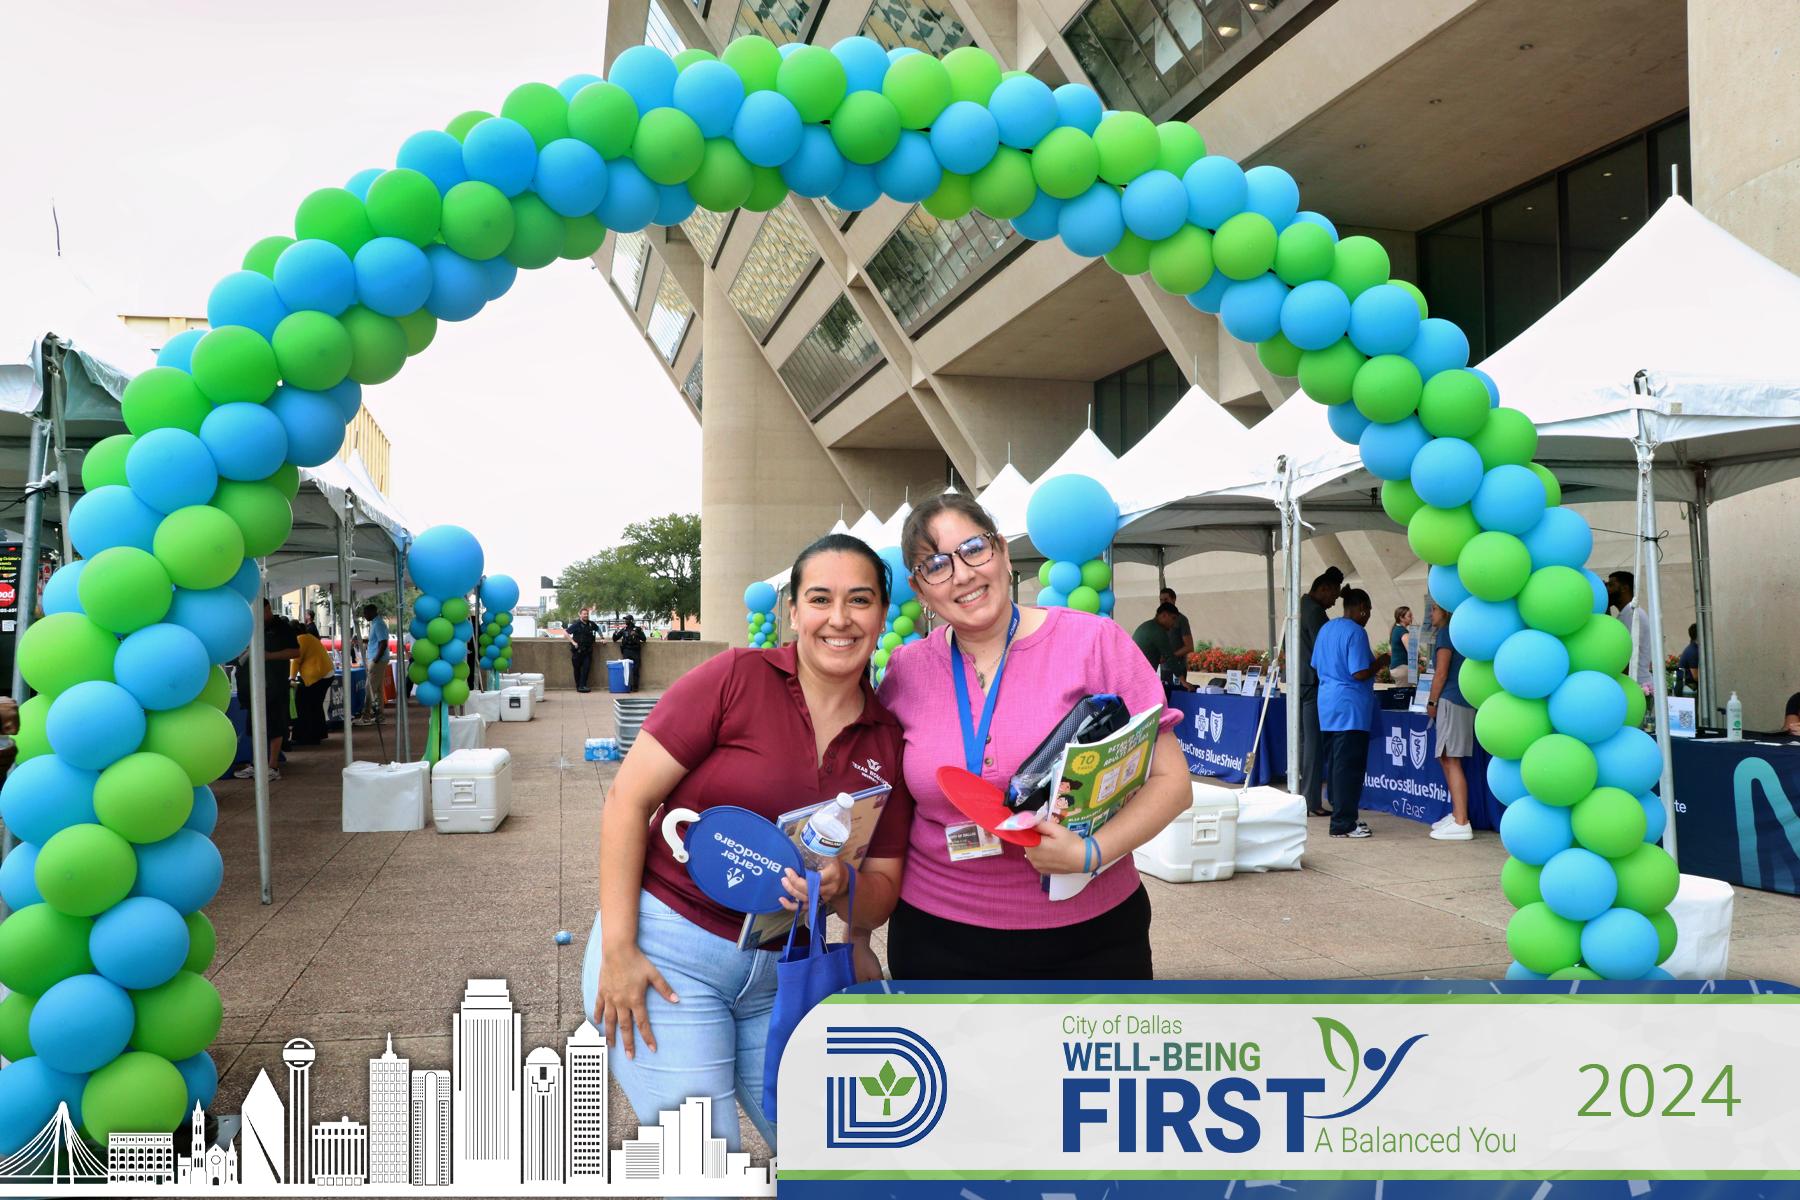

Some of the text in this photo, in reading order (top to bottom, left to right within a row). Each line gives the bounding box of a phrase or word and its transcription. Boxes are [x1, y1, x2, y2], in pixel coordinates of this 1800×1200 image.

[1205, 749, 1242, 771] BlueShield
[1363, 772, 1407, 793] lueCross
[714, 832, 782, 873] BloodCare
[721, 850, 763, 876] Carter
